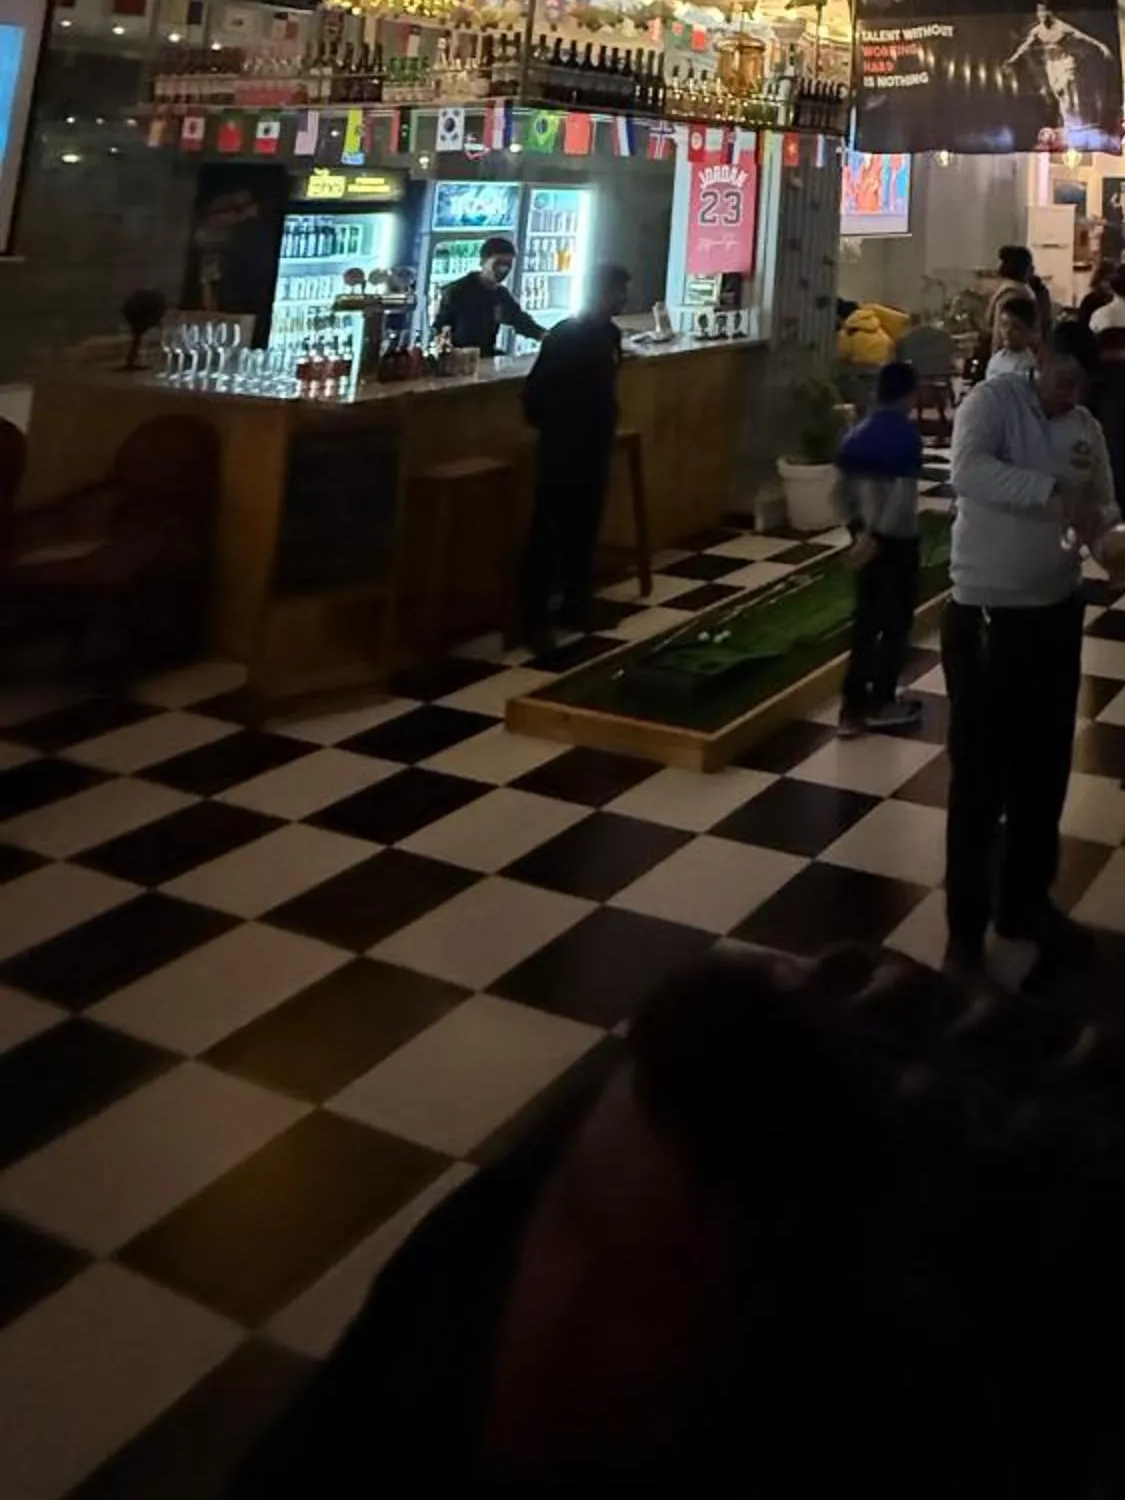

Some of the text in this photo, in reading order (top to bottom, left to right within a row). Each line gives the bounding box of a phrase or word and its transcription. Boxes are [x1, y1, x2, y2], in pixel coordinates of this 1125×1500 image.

[861, 24, 954, 42] TALENT WITHOUT
[863, 72, 929, 88] IS NOTHING
[698, 165, 749, 189] JORDAN
[698, 189, 744, 227] 23
